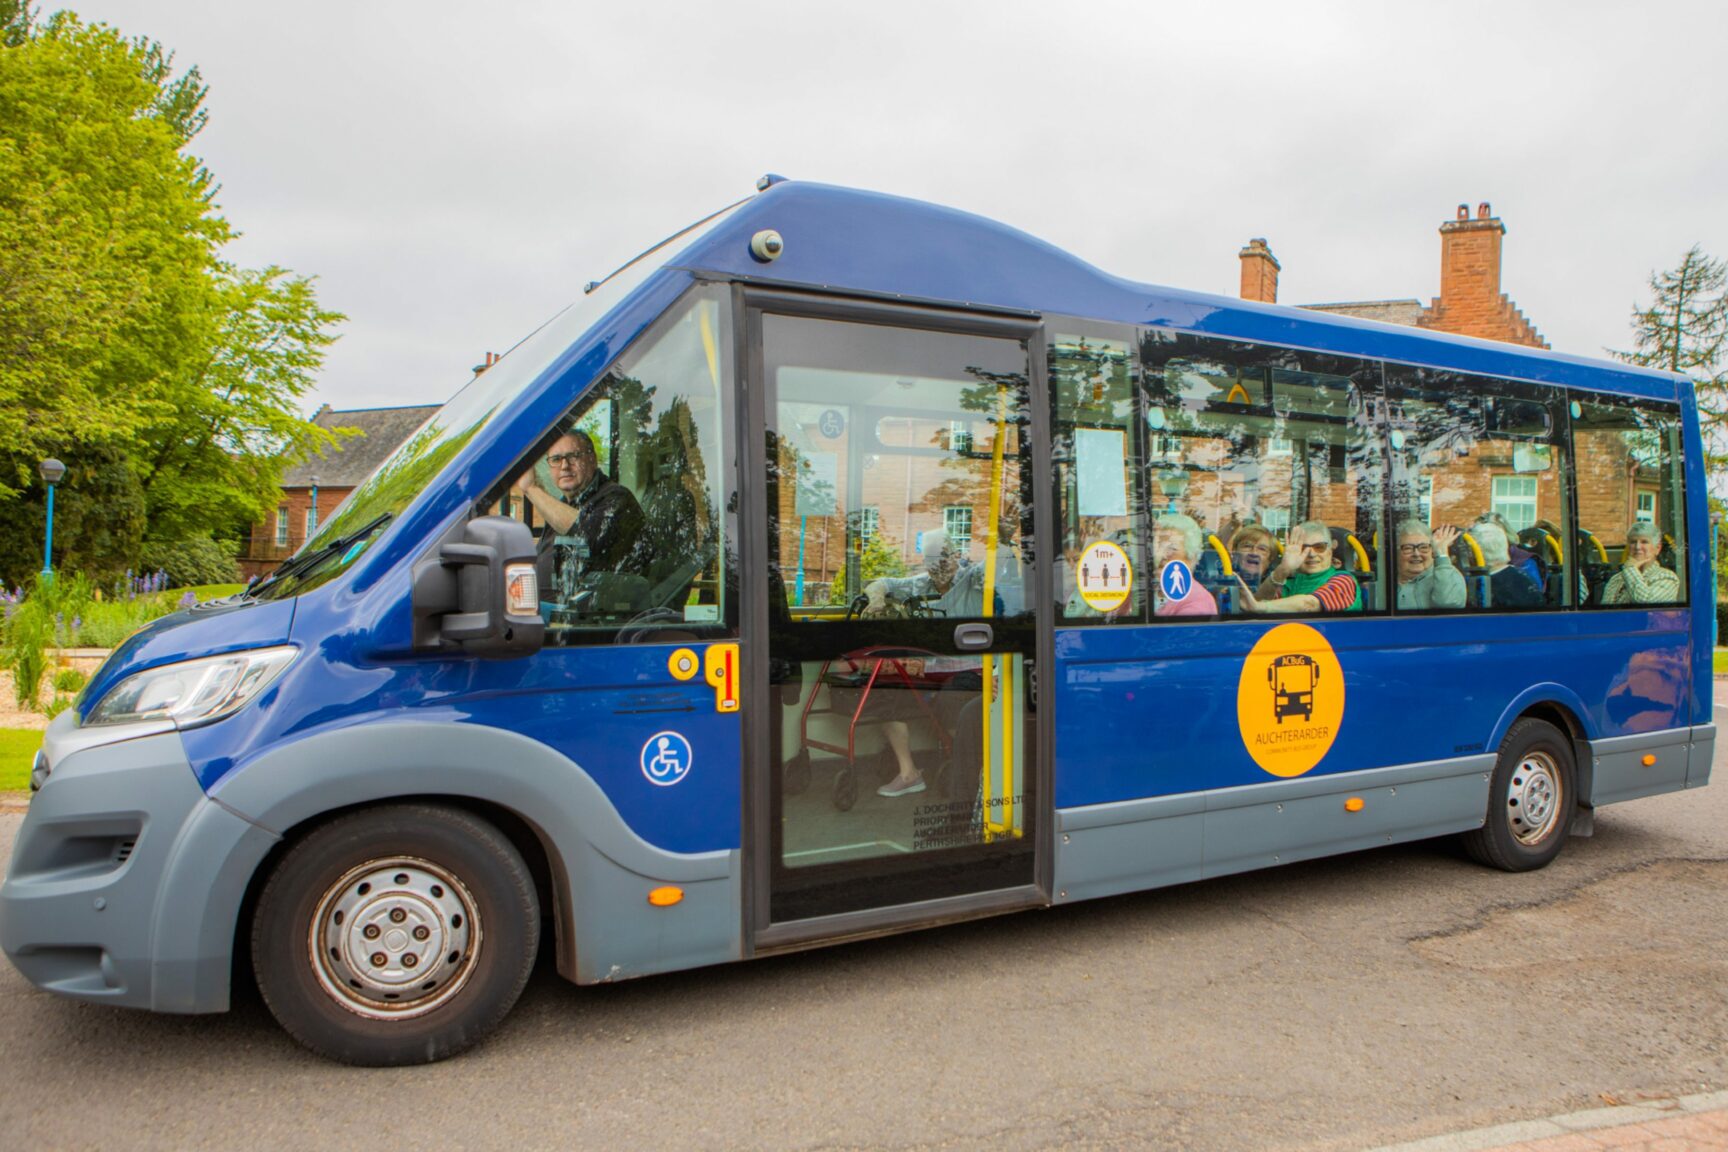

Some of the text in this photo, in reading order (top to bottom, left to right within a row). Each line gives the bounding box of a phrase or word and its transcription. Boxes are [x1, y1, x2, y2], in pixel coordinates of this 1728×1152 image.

[1095, 549, 1114, 559] 1m+
[1255, 726, 1329, 745] AUCHTERARDER
[985, 797, 1011, 808] SONS
